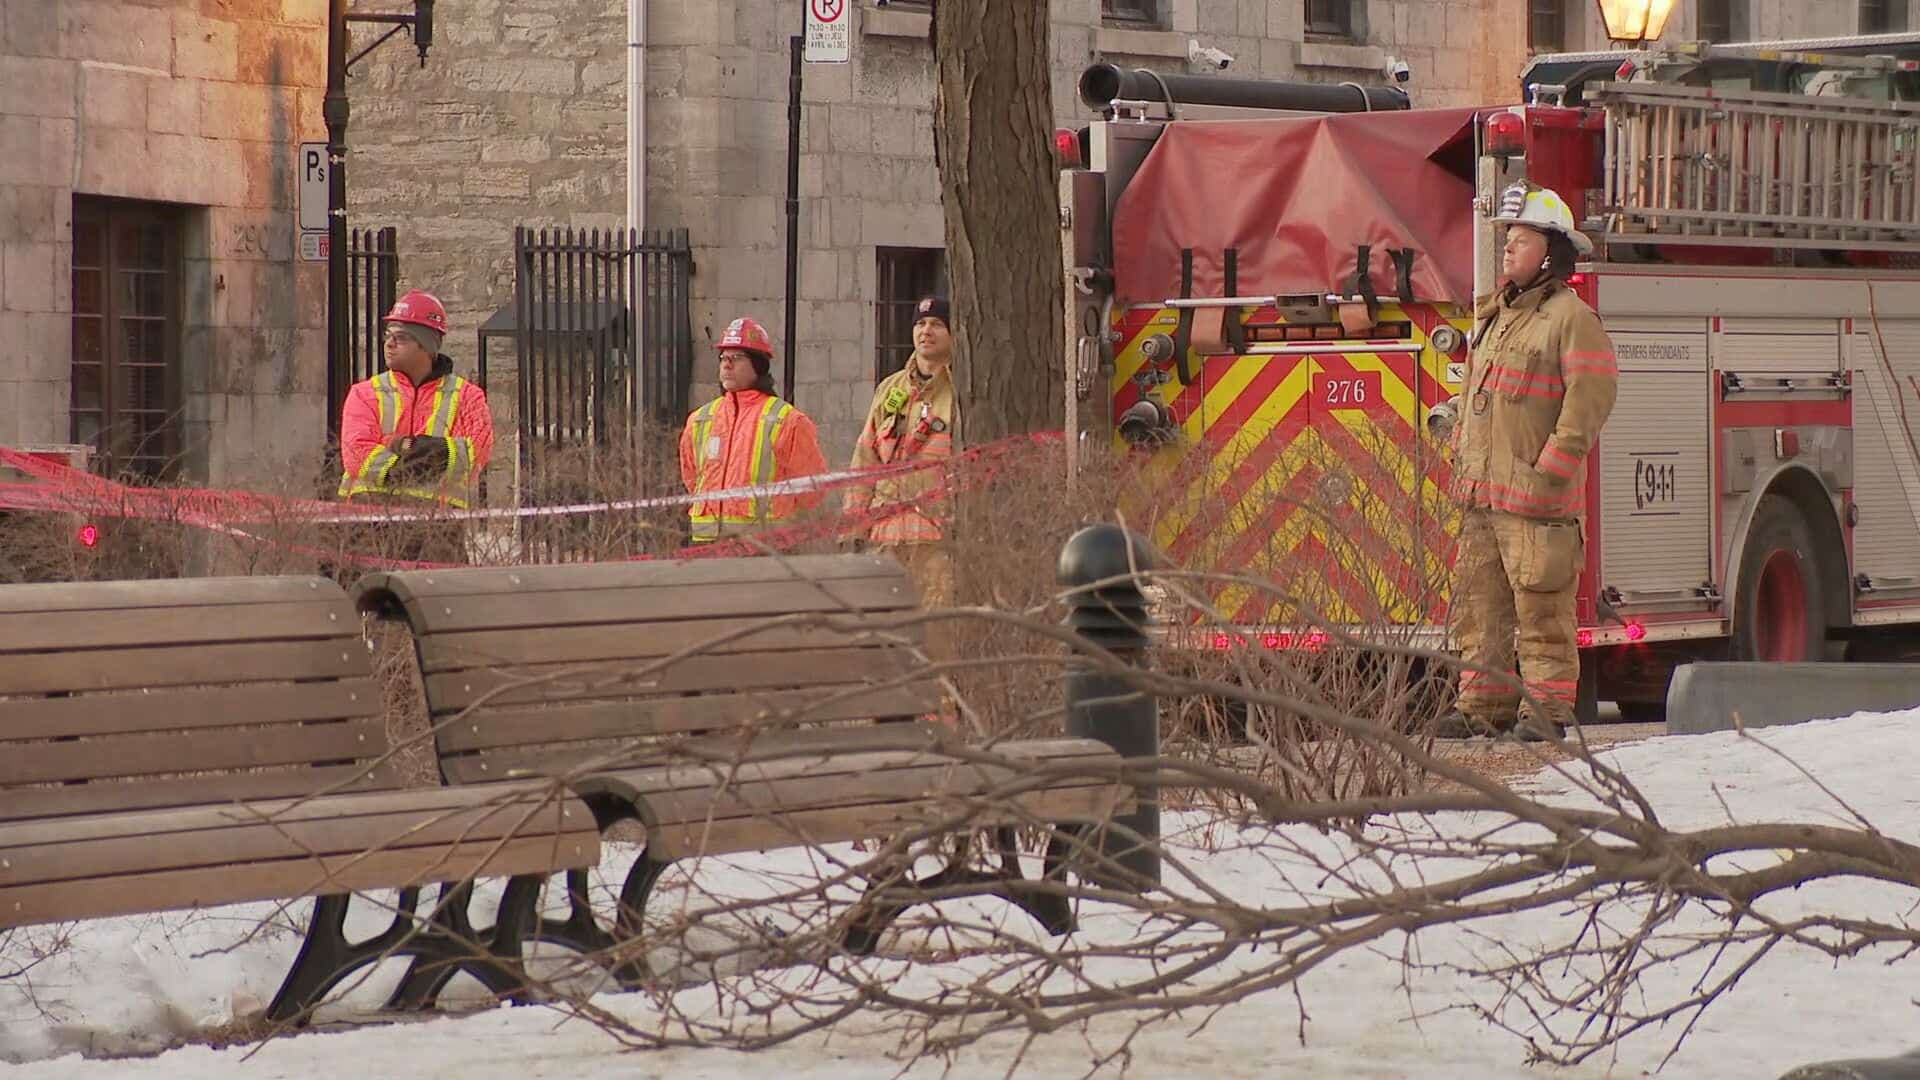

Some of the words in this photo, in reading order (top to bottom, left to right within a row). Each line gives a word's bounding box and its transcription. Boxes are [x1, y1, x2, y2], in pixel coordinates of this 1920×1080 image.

[1617, 344, 1648, 360] PREMIERS
[1648, 341, 1690, 361] RÉPONDANTS
[1327, 379, 1366, 403] 276
